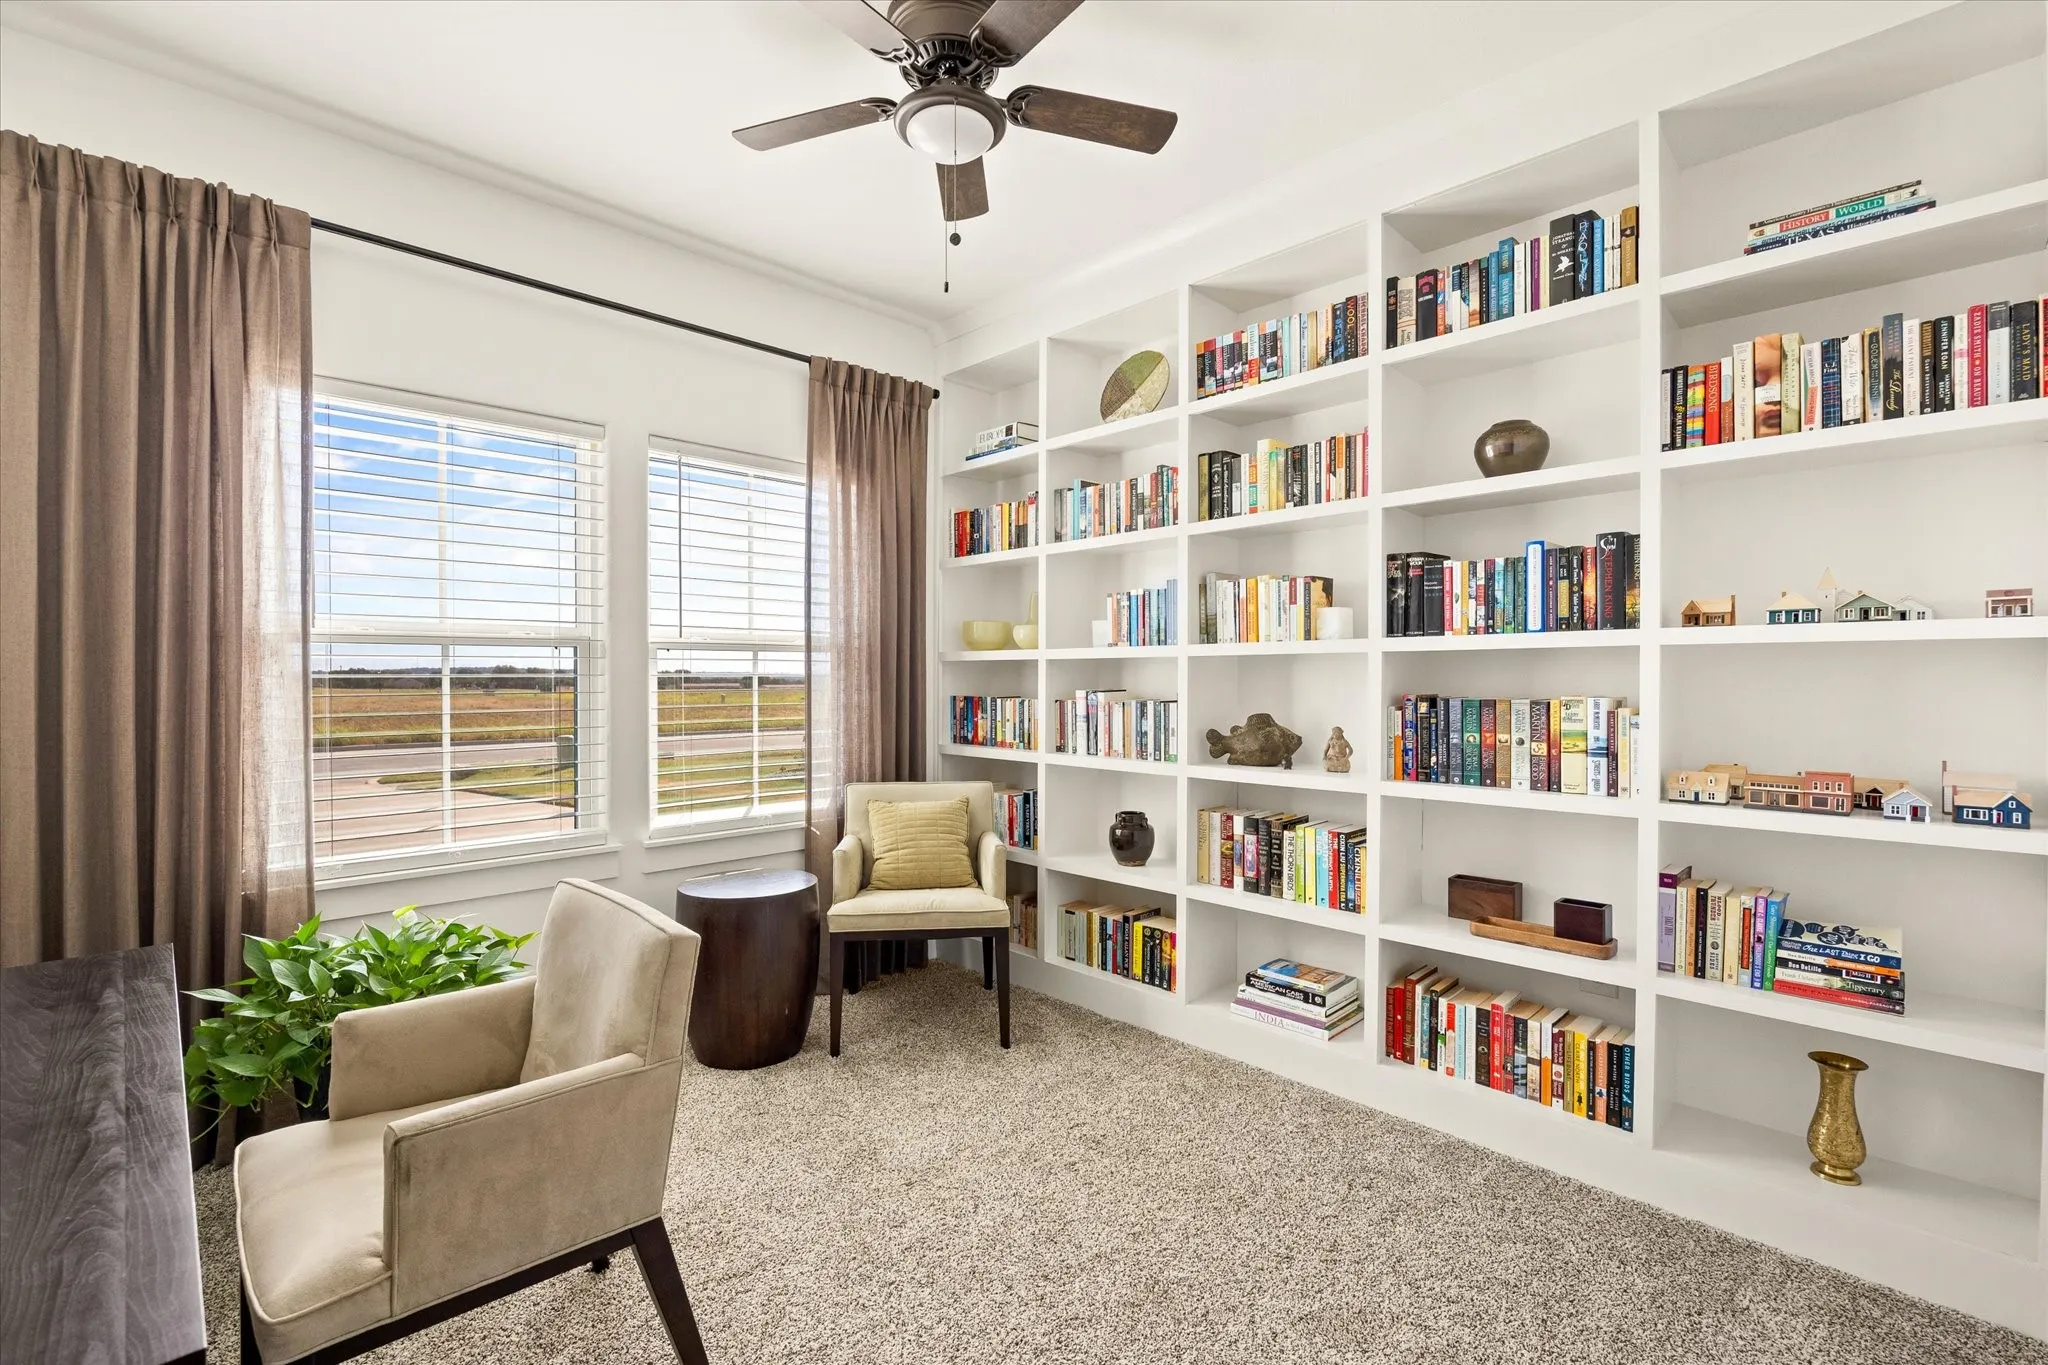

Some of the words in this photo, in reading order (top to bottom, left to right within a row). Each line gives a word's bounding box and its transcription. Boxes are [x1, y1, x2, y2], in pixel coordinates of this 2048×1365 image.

[1837, 198, 1884, 217] WORLD
[1782, 212, 1829, 231] HISTORY
[1785, 228, 1836, 246] TEXAS
[1347, 299, 1355, 330] WOOL
[1973, 312, 1982, 333] ZADIE
[1940, 320, 1949, 350] JENNIFER
[2022, 323, 2032, 355] LADY'S
[1265, 333, 1273, 359] malone
[1973, 335, 1982, 359] SMITH
[1940, 352, 1949, 370] EGAN
[2022, 357, 2032, 381] MAID
[1973, 366, 1982, 378] ON
[1708, 363, 1718, 413] BIRDSONG
[1886, 380, 1902, 411] Remedy
[1973, 379, 1982, 406] BEAUTY
[980, 428, 1006, 443] EUROPE
[1604, 551, 1613, 592] STEPHEN
[1604, 595, 1613, 618] KING
[1465, 707, 1473, 730] MARTIN
[1514, 708, 1522, 734] MARTIN
[1532, 704, 1541, 741] MARTIN
[1532, 757, 1540, 781] BLOOD
[1540, 771, 1547, 780] &
[1287, 835, 1295, 848] THE
[1287, 848, 1295, 873] THORN
[1286, 873, 1295, 891] BIRDS
[1802, 944, 1818, 952] One
[1819, 948, 1840, 956] LAST
[1867, 955, 1880, 963] GO
[1781, 970, 1797, 978] Frank
[1800, 963, 1822, 973] DeLillo
[1250, 980, 1286, 993] AMERICAN
[1286, 989, 1304, 997] CARS
[1779, 983, 1808, 993] JOSEPH
[1811, 990, 1840, 999] KANON
[1847, 982, 1886, 996] Tipperary
[1869, 1001, 1893, 1009] PASSAGE
[1254, 1011, 1285, 1028] INDIA
